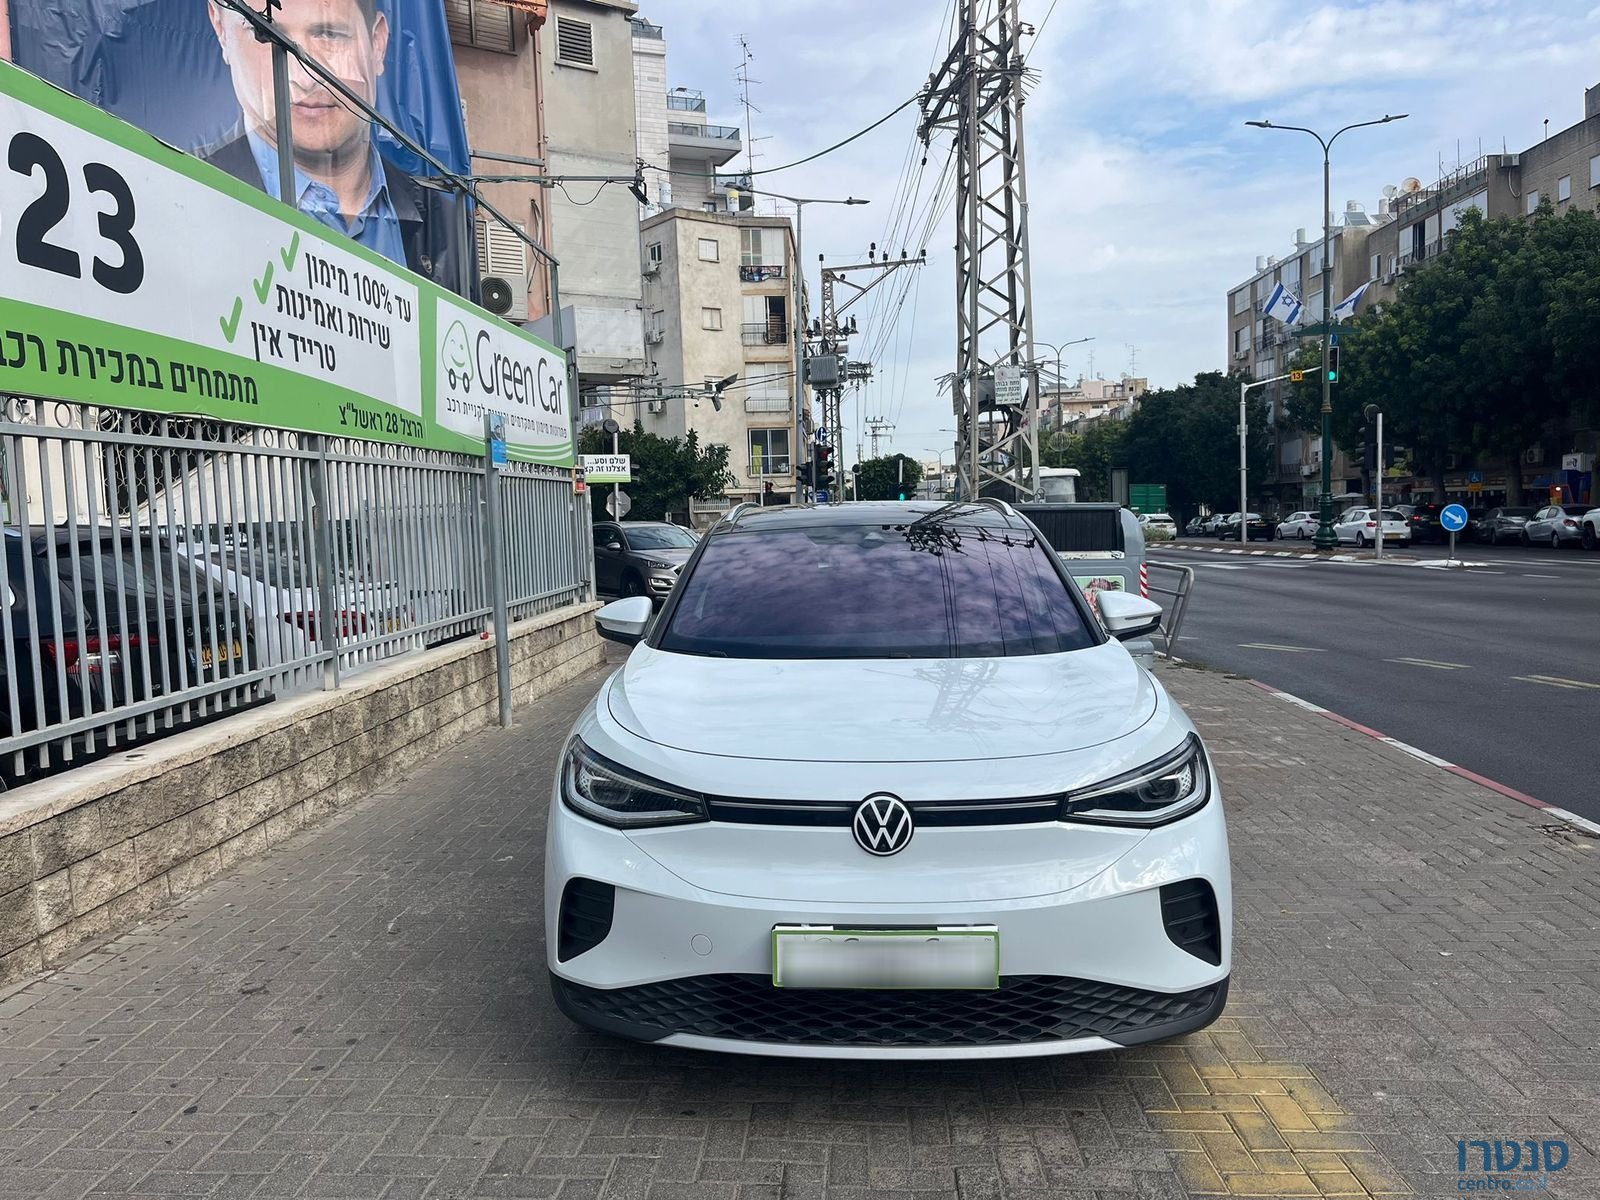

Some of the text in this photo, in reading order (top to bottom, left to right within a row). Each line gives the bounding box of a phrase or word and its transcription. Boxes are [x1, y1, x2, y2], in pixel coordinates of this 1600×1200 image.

[8, 132, 144, 294] 23
[305, 252, 411, 322] עד 100% מימון
[276, 284, 390, 349] שירות ואמינות
[55, 339, 164, 390] במכירת
[251, 321, 336, 371] טרייד אין
[169, 361, 258, 405] מתמחים
[476, 330, 562, 415] Green Car
[1293, 372, 1301, 380] 13
[385, 411, 398, 434] 28
[400, 414, 423, 438] הרצל
[446, 397, 461, 413] רכב
[606, 464, 626, 472] אצלנו
[609, 457, 626, 465] שלם
[853, 795, 912, 855] VW
